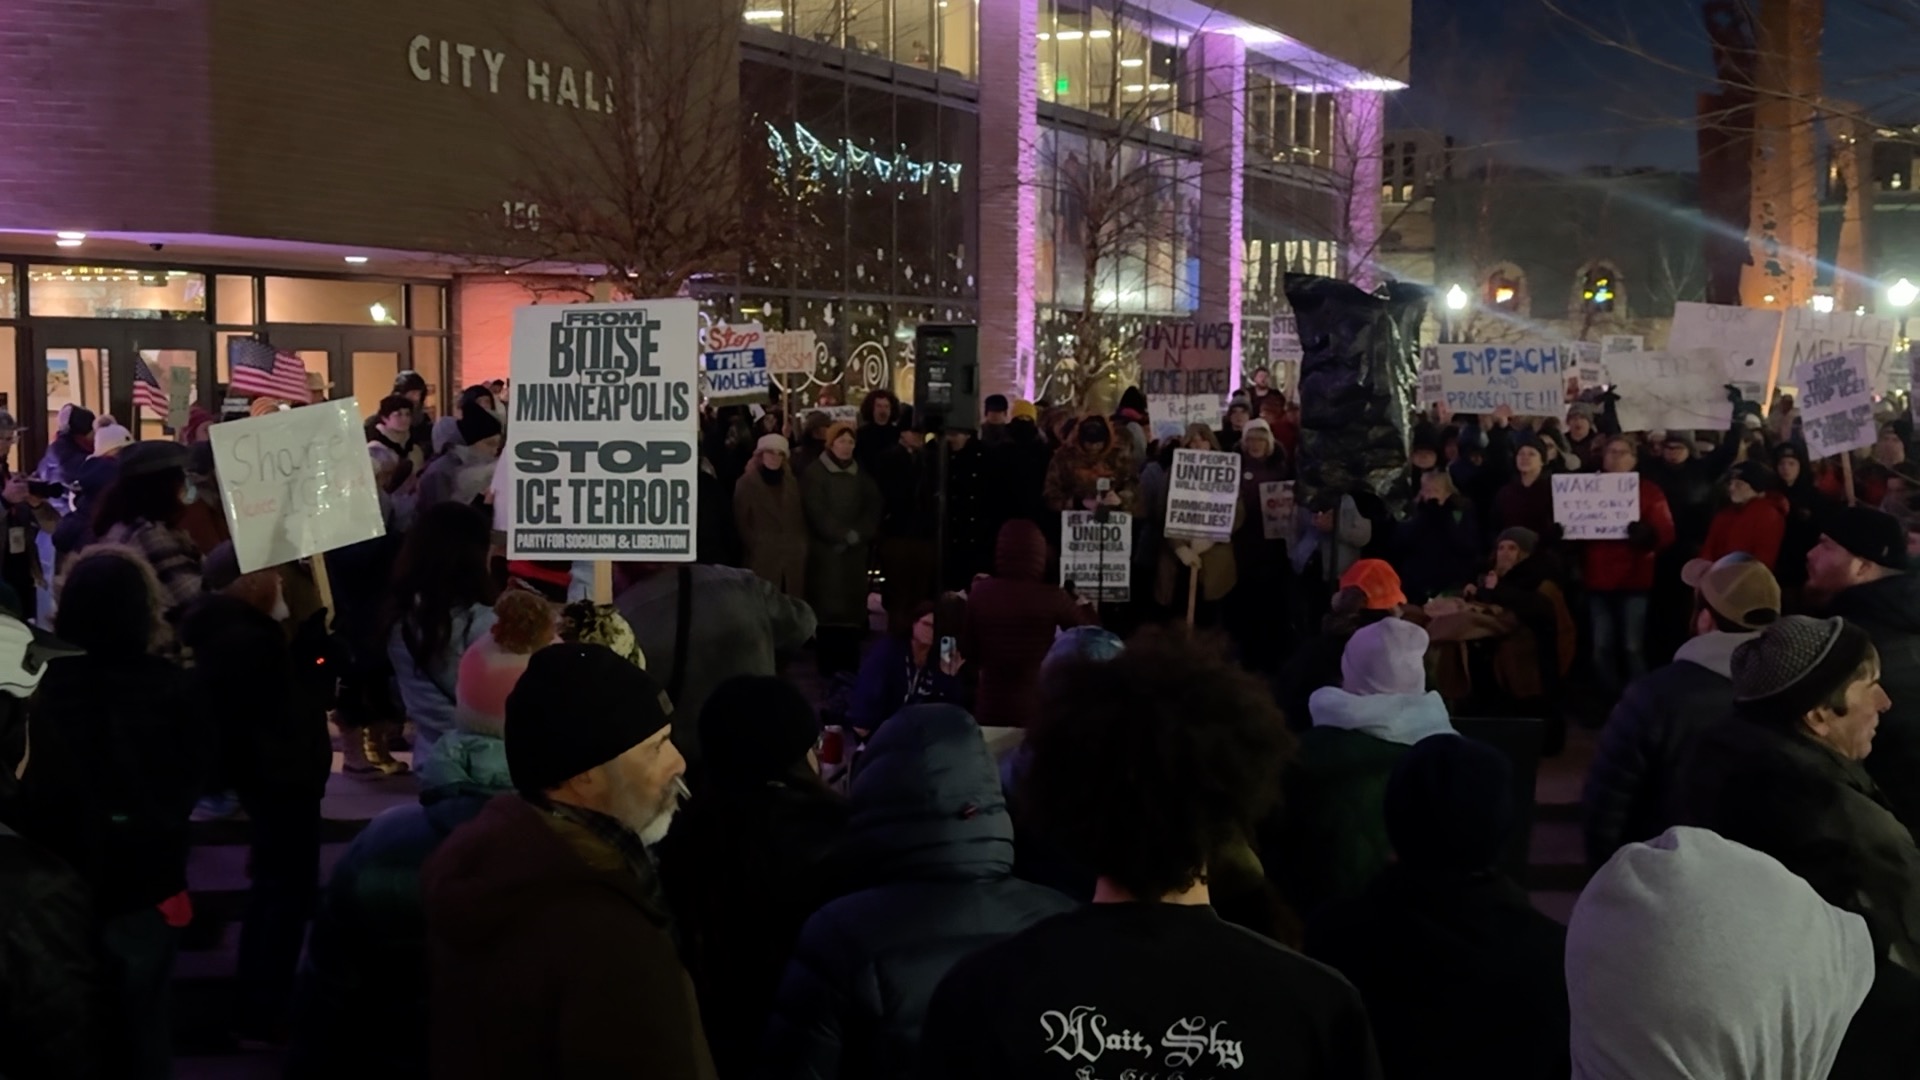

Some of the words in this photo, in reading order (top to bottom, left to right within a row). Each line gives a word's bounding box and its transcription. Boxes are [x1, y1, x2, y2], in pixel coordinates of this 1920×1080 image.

[408, 34, 505, 93] CITY
[566, 311, 643, 327] FROM
[549, 320, 661, 378] BOISE
[709, 328, 760, 351] Stop
[713, 351, 755, 369] THE
[1453, 347, 1558, 375] IMPEACH
[1813, 356, 1846, 375] STOP
[584, 370, 622, 384] TO
[709, 371, 769, 391] VIOLENCE
[1488, 376, 1519, 389] AND
[515, 381, 690, 422] MINNEAPOLIS
[514, 440, 692, 474] STOP
[1176, 464, 1236, 483] UNITED
[1553, 477, 1603, 493] WAKE
[516, 478, 562, 525] ICE
[568, 478, 690, 525] TERROR
[1171, 499, 1233, 514] IMMIGRANT
[1169, 511, 1232, 528] FAMILIES!
[516, 533, 548, 549] PARTY
[548, 533, 566, 549] FOR
[566, 533, 617, 549] SOCIALISM
[617, 533, 631, 549] &
[632, 533, 687, 549] LIBERATION
[1040, 1005, 1153, 1063] Wait,
[1161, 1015, 1244, 1069] Sky
